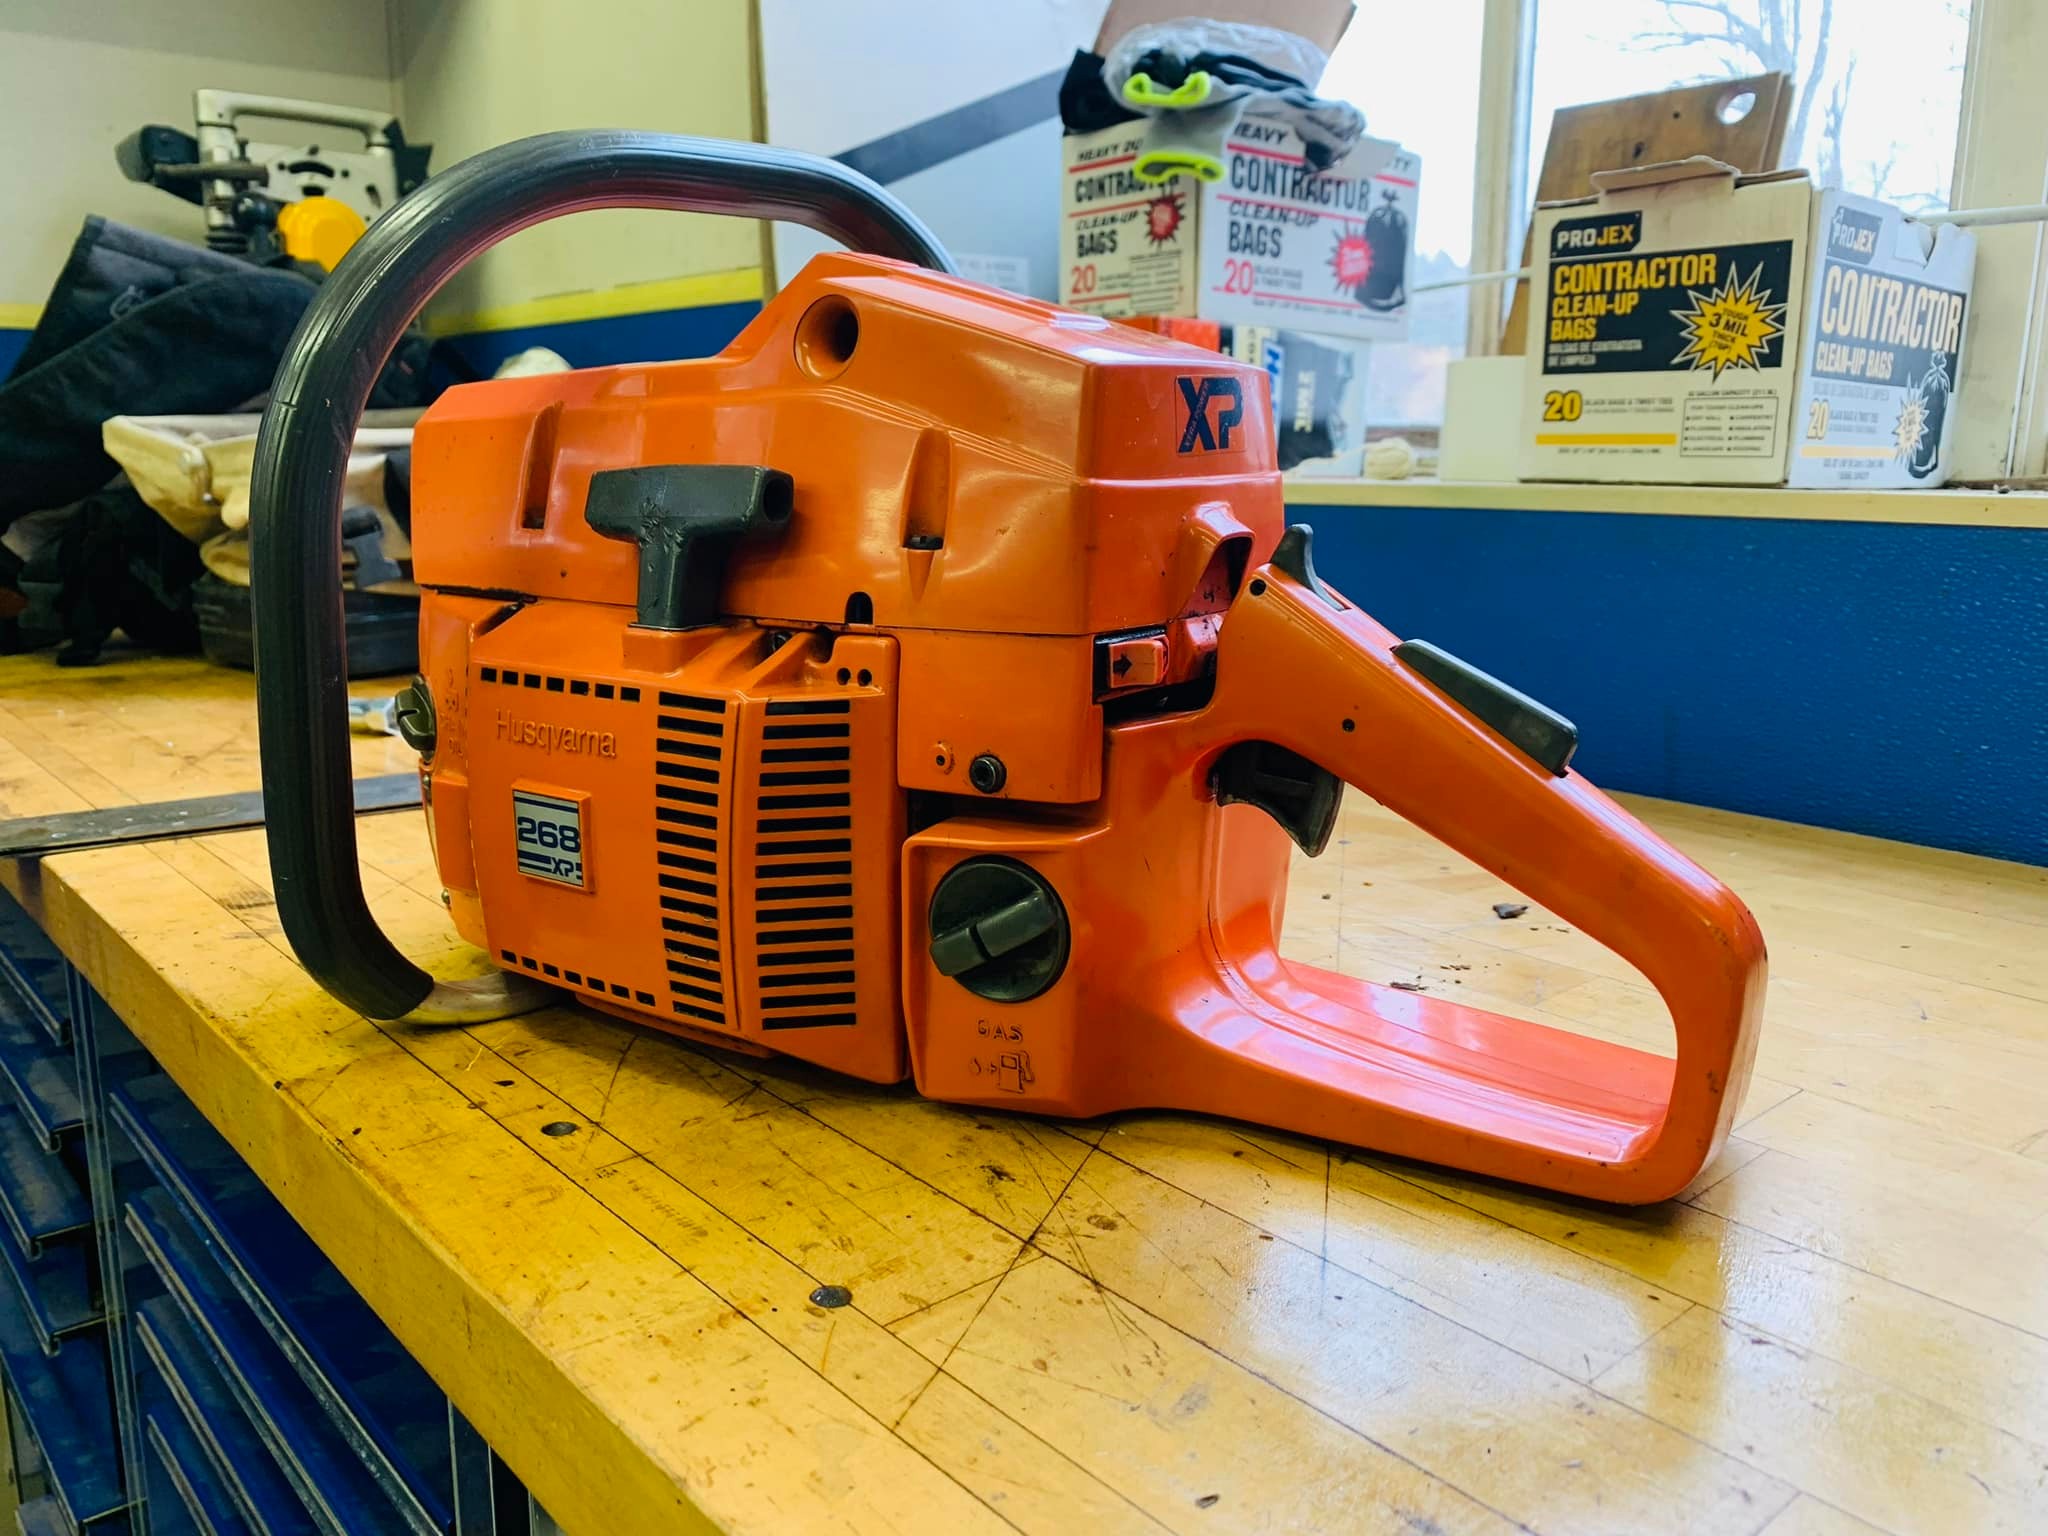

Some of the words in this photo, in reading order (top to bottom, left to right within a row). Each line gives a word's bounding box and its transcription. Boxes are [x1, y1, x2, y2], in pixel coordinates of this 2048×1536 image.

[1231, 154, 1371, 213] CONTRACTOR
[1077, 210, 1139, 230] CLEAN-UP
[1229, 199, 1320, 227] CLEAN-UP
[1077, 230, 1118, 258] BAGS
[1228, 220, 1282, 258] BAGS
[1556, 224, 1635, 249] PROJEX
[1832, 222, 1876, 254] PROJEX
[1071, 264, 1095, 294] 20
[1224, 258, 1254, 295] 20
[1554, 253, 1718, 295] CONTRACTOR
[1552, 291, 1640, 319] CLEAN-UP
[1821, 264, 1963, 353] CONTRACTOR
[1550, 317, 1597, 341] BAGS
[1709, 312, 1722, 328] 3
[1723, 319, 1748, 337] MIL
[1816, 341, 1866, 375] CLEAN-UP
[1866, 347, 1895, 380] BAGS
[1178, 376, 1244, 454] XP
[1542, 390, 1583, 422] 20
[1806, 397, 1830, 440] 20
[496, 708, 618, 760] Husqvarna
[517, 816, 581, 854] 268
[551, 856, 575, 878] XP
[977, 1018, 1025, 1043] GAS
